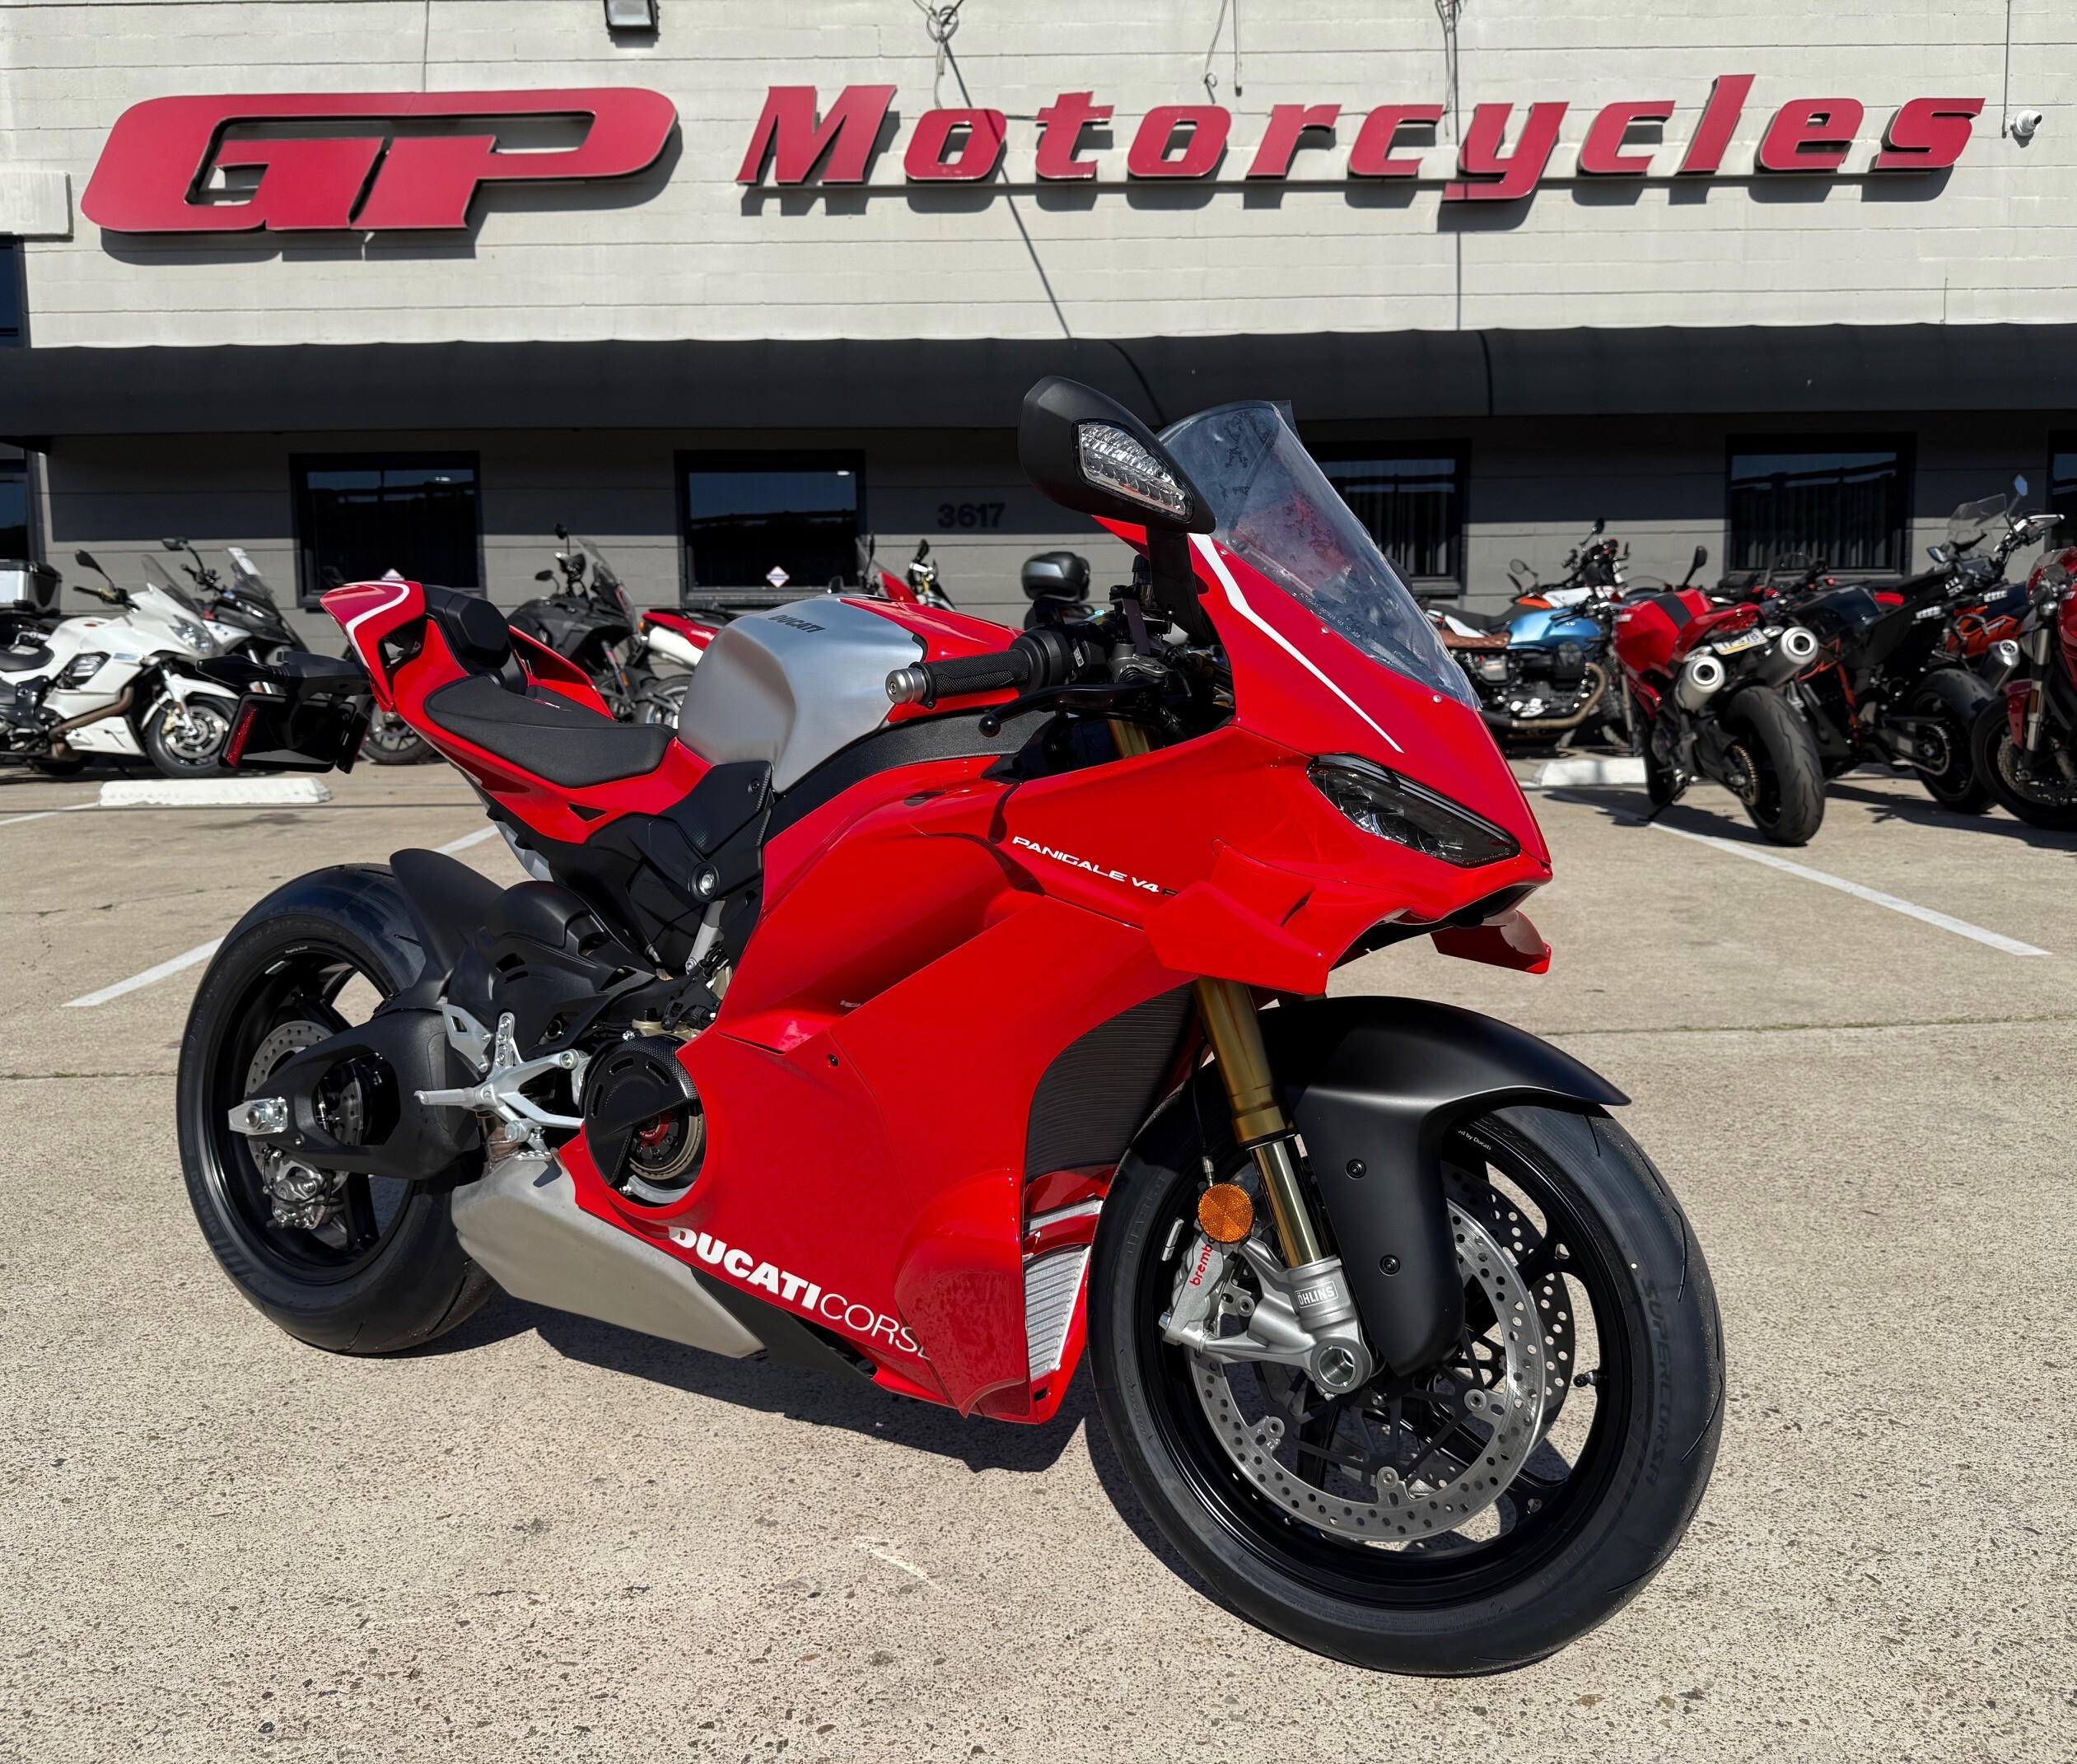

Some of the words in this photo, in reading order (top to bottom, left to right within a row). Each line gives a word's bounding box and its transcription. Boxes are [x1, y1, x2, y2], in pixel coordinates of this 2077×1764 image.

[81, 86, 678, 231] GP
[735, 73, 1986, 202] Motorcycles
[937, 502, 1006, 529] 3617
[768, 614, 826, 633] DUCATI
[1012, 836, 1127, 882] PANIGALE
[1131, 876, 1160, 893] V4
[1473, 1136, 1491, 1150] Ducati
[1297, 1285, 1337, 1307] ÖHLINS
[1641, 1276, 1673, 1488] SUPERCORSA
